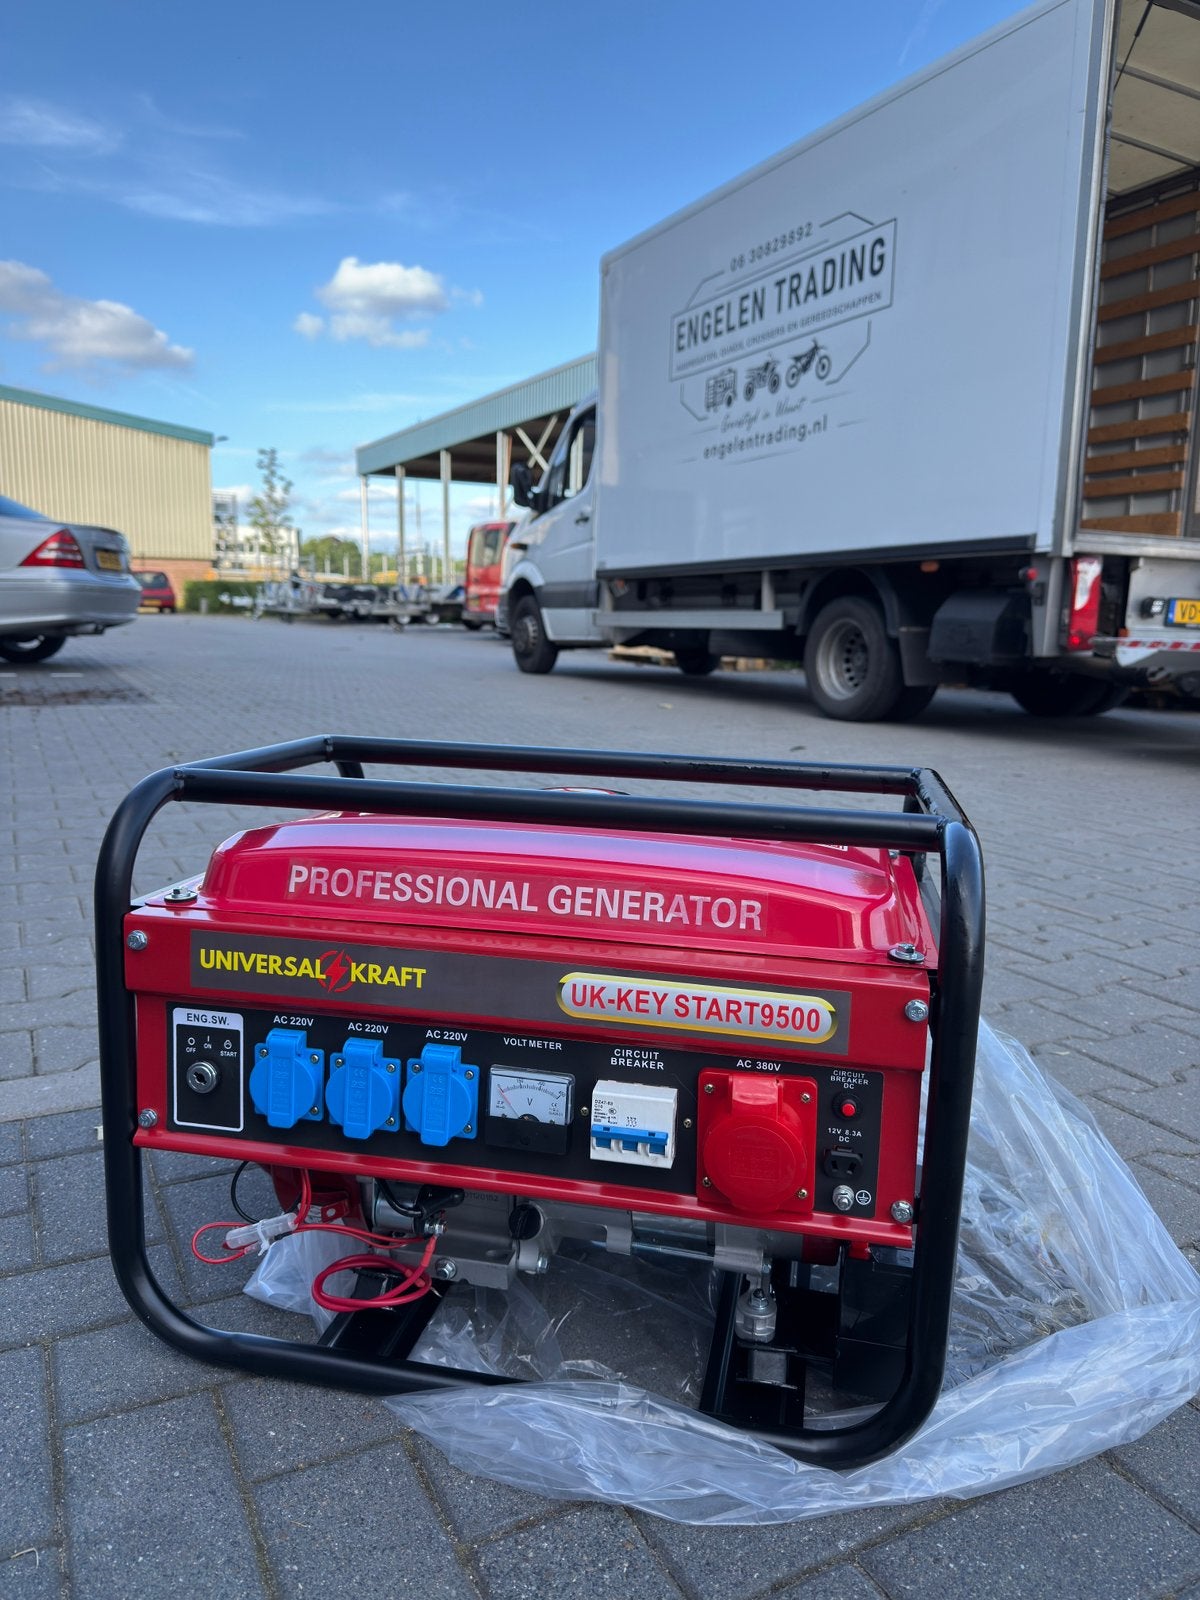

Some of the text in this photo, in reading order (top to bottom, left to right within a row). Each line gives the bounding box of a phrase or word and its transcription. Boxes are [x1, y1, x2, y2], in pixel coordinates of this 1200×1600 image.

[730, 254, 745, 272] 06
[676, 237, 886, 352] ENGELEN TRADING
[704, 414, 828, 460] engelentrading.nl
[288, 865, 763, 931] PROFESSIONAL GENERATOR
[199, 949, 427, 988] UNIVERSAL KRAFT
[571, 983, 821, 1033] UK-KEY START9500
[186, 1012, 230, 1026] ENG.SW.
[273, 1015, 314, 1027] AC 220V
[347, 1022, 389, 1034] AC 220V
[425, 1029, 468, 1042] AC 220V
[503, 1037, 562, 1051] VOLT METER
[614, 1048, 660, 1061] CIRCUIT
[610, 1057, 664, 1070] BREAKER
[736, 1059, 781, 1072] AC 380V
[830, 1075, 869, 1085] BREAKER
[833, 1069, 866, 1079] CIRCUIT
[843, 1082, 855, 1090] DC
[527, 1097, 534, 1106] V
[828, 1127, 862, 1137] 12V 8.3A
[838, 1135, 850, 1143] DC
